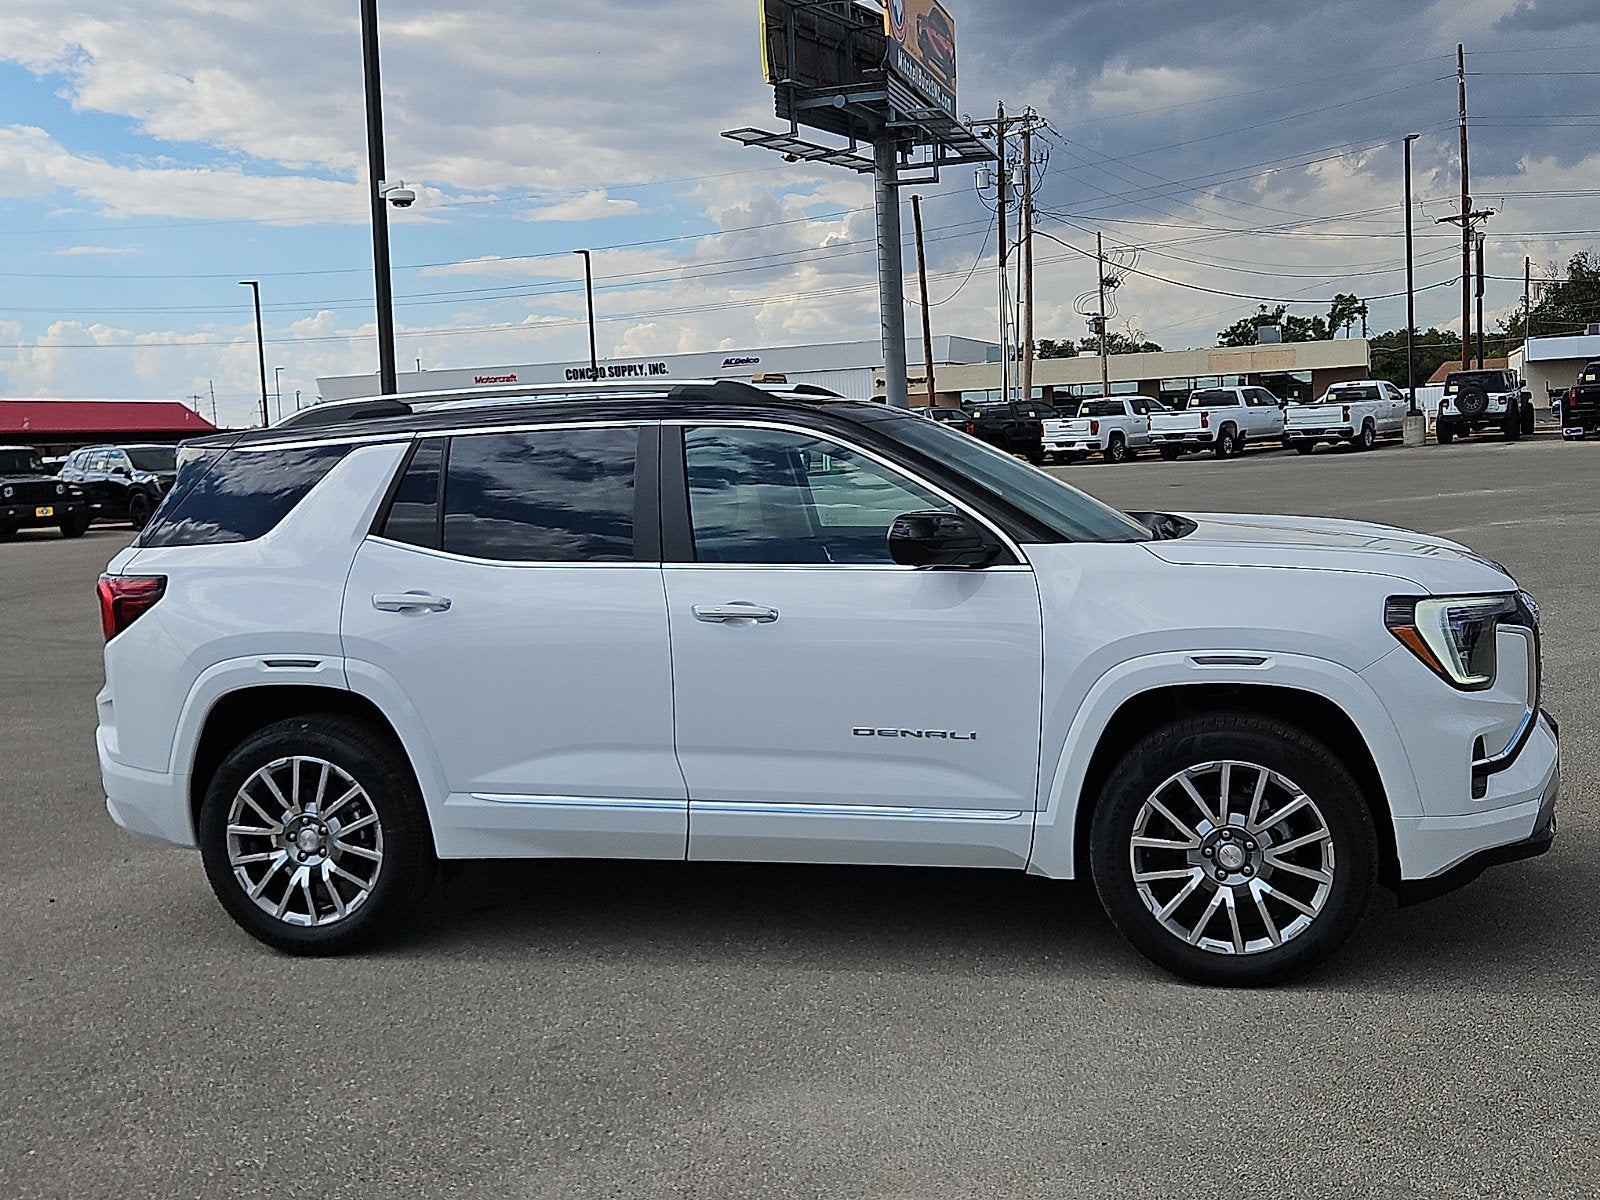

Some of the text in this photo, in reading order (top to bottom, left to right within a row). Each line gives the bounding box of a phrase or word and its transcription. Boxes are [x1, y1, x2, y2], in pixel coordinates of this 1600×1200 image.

[565, 362, 669, 380] CONCO SUPPLY, INC.
[852, 727, 976, 740] DENALI
